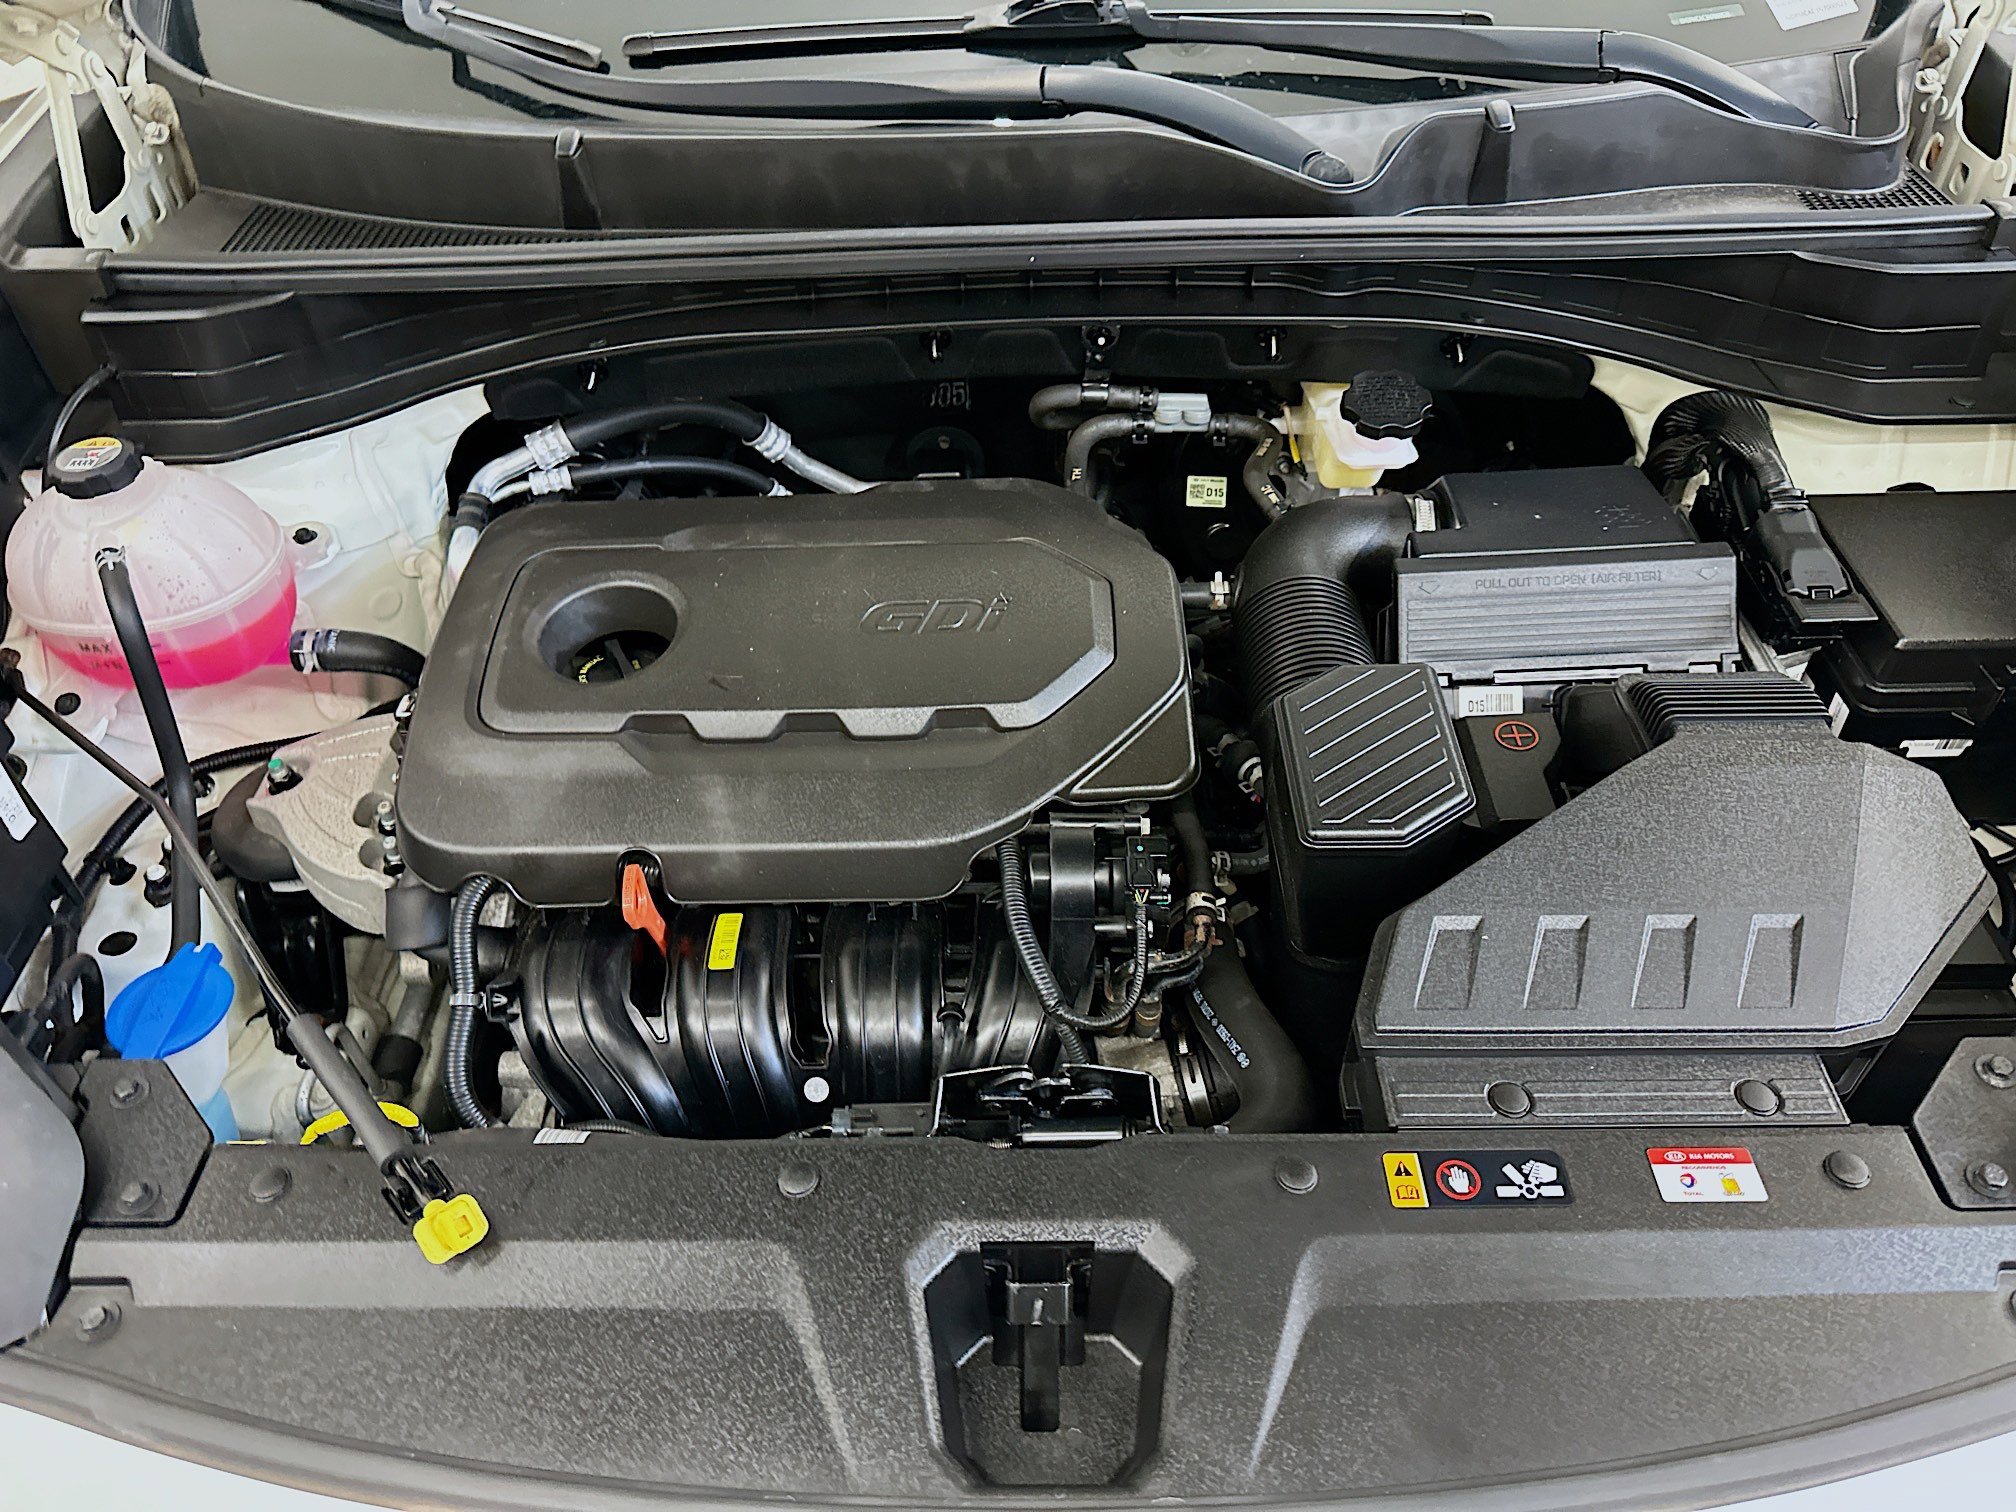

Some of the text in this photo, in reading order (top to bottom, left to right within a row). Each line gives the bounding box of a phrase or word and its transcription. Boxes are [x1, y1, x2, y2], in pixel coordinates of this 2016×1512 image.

[1475, 579, 1505, 590] PULL
[1508, 577, 1532, 588] OUT
[1536, 576, 1550, 587] TO
[1554, 574, 1586, 586] OPEN
[78, 643, 111, 654] MAX
[1665, 1152, 1686, 1161] KIA
[1703, 1152, 1735, 1160] MOTORS
